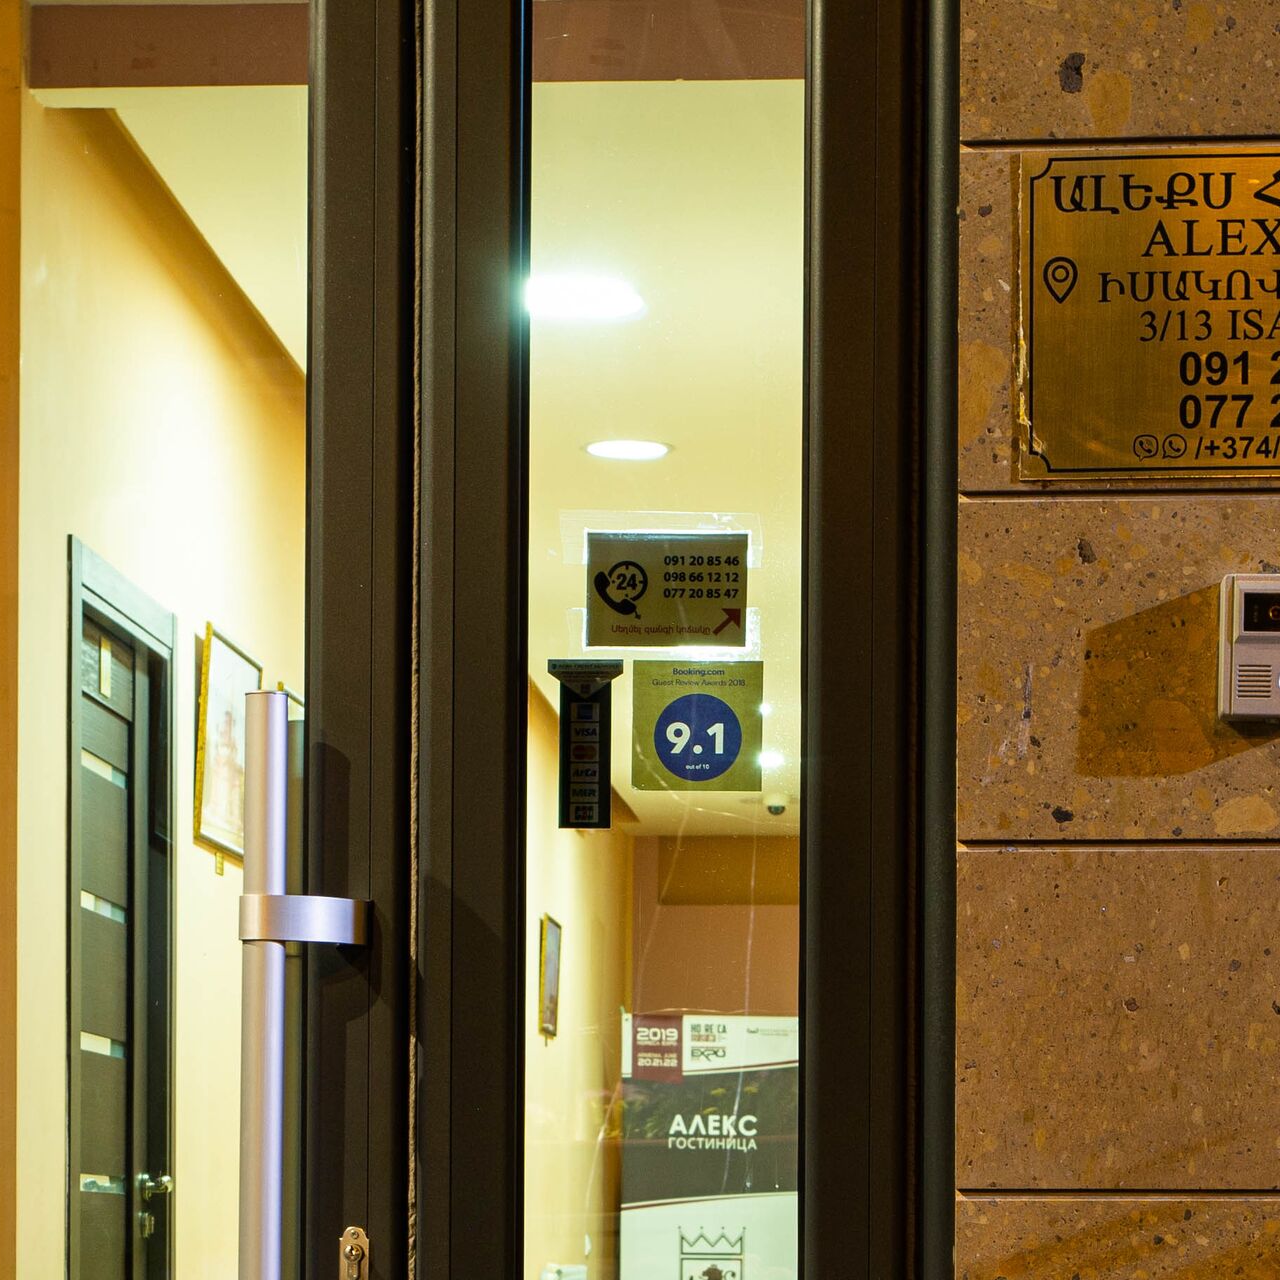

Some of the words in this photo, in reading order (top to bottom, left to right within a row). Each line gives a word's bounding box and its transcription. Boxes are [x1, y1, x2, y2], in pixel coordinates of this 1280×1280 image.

[1050, 172, 1236, 214] ԱԼԵՔՍ
[1139, 308, 1213, 342] 3/13
[1179, 351, 1250, 385] 091
[1179, 393, 1254, 429] 077
[1195, 435, 1280, 459] /+374/
[664, 556, 685, 566] 091
[689, 556, 704, 566] 20
[706, 556, 721, 566] 85
[724, 556, 739, 566] 46
[616, 573, 638, 590] 24
[664, 572, 686, 582] 098
[689, 572, 704, 582] 66
[708, 572, 721, 582] 12
[725, 572, 739, 582] 12
[663, 588, 685, 598] 077
[689, 588, 704, 598] 20
[706, 588, 721, 598] 85
[724, 588, 739, 598] 47
[672, 668, 725, 676] Booking.com
[574, 727, 597, 737] VISA
[666, 722, 724, 754] 9.1
[636, 1027, 679, 1041] 2019
[668, 1113, 758, 1136] АЛЕКС
[668, 1136, 758, 1153] ГОСТИНИЦА
